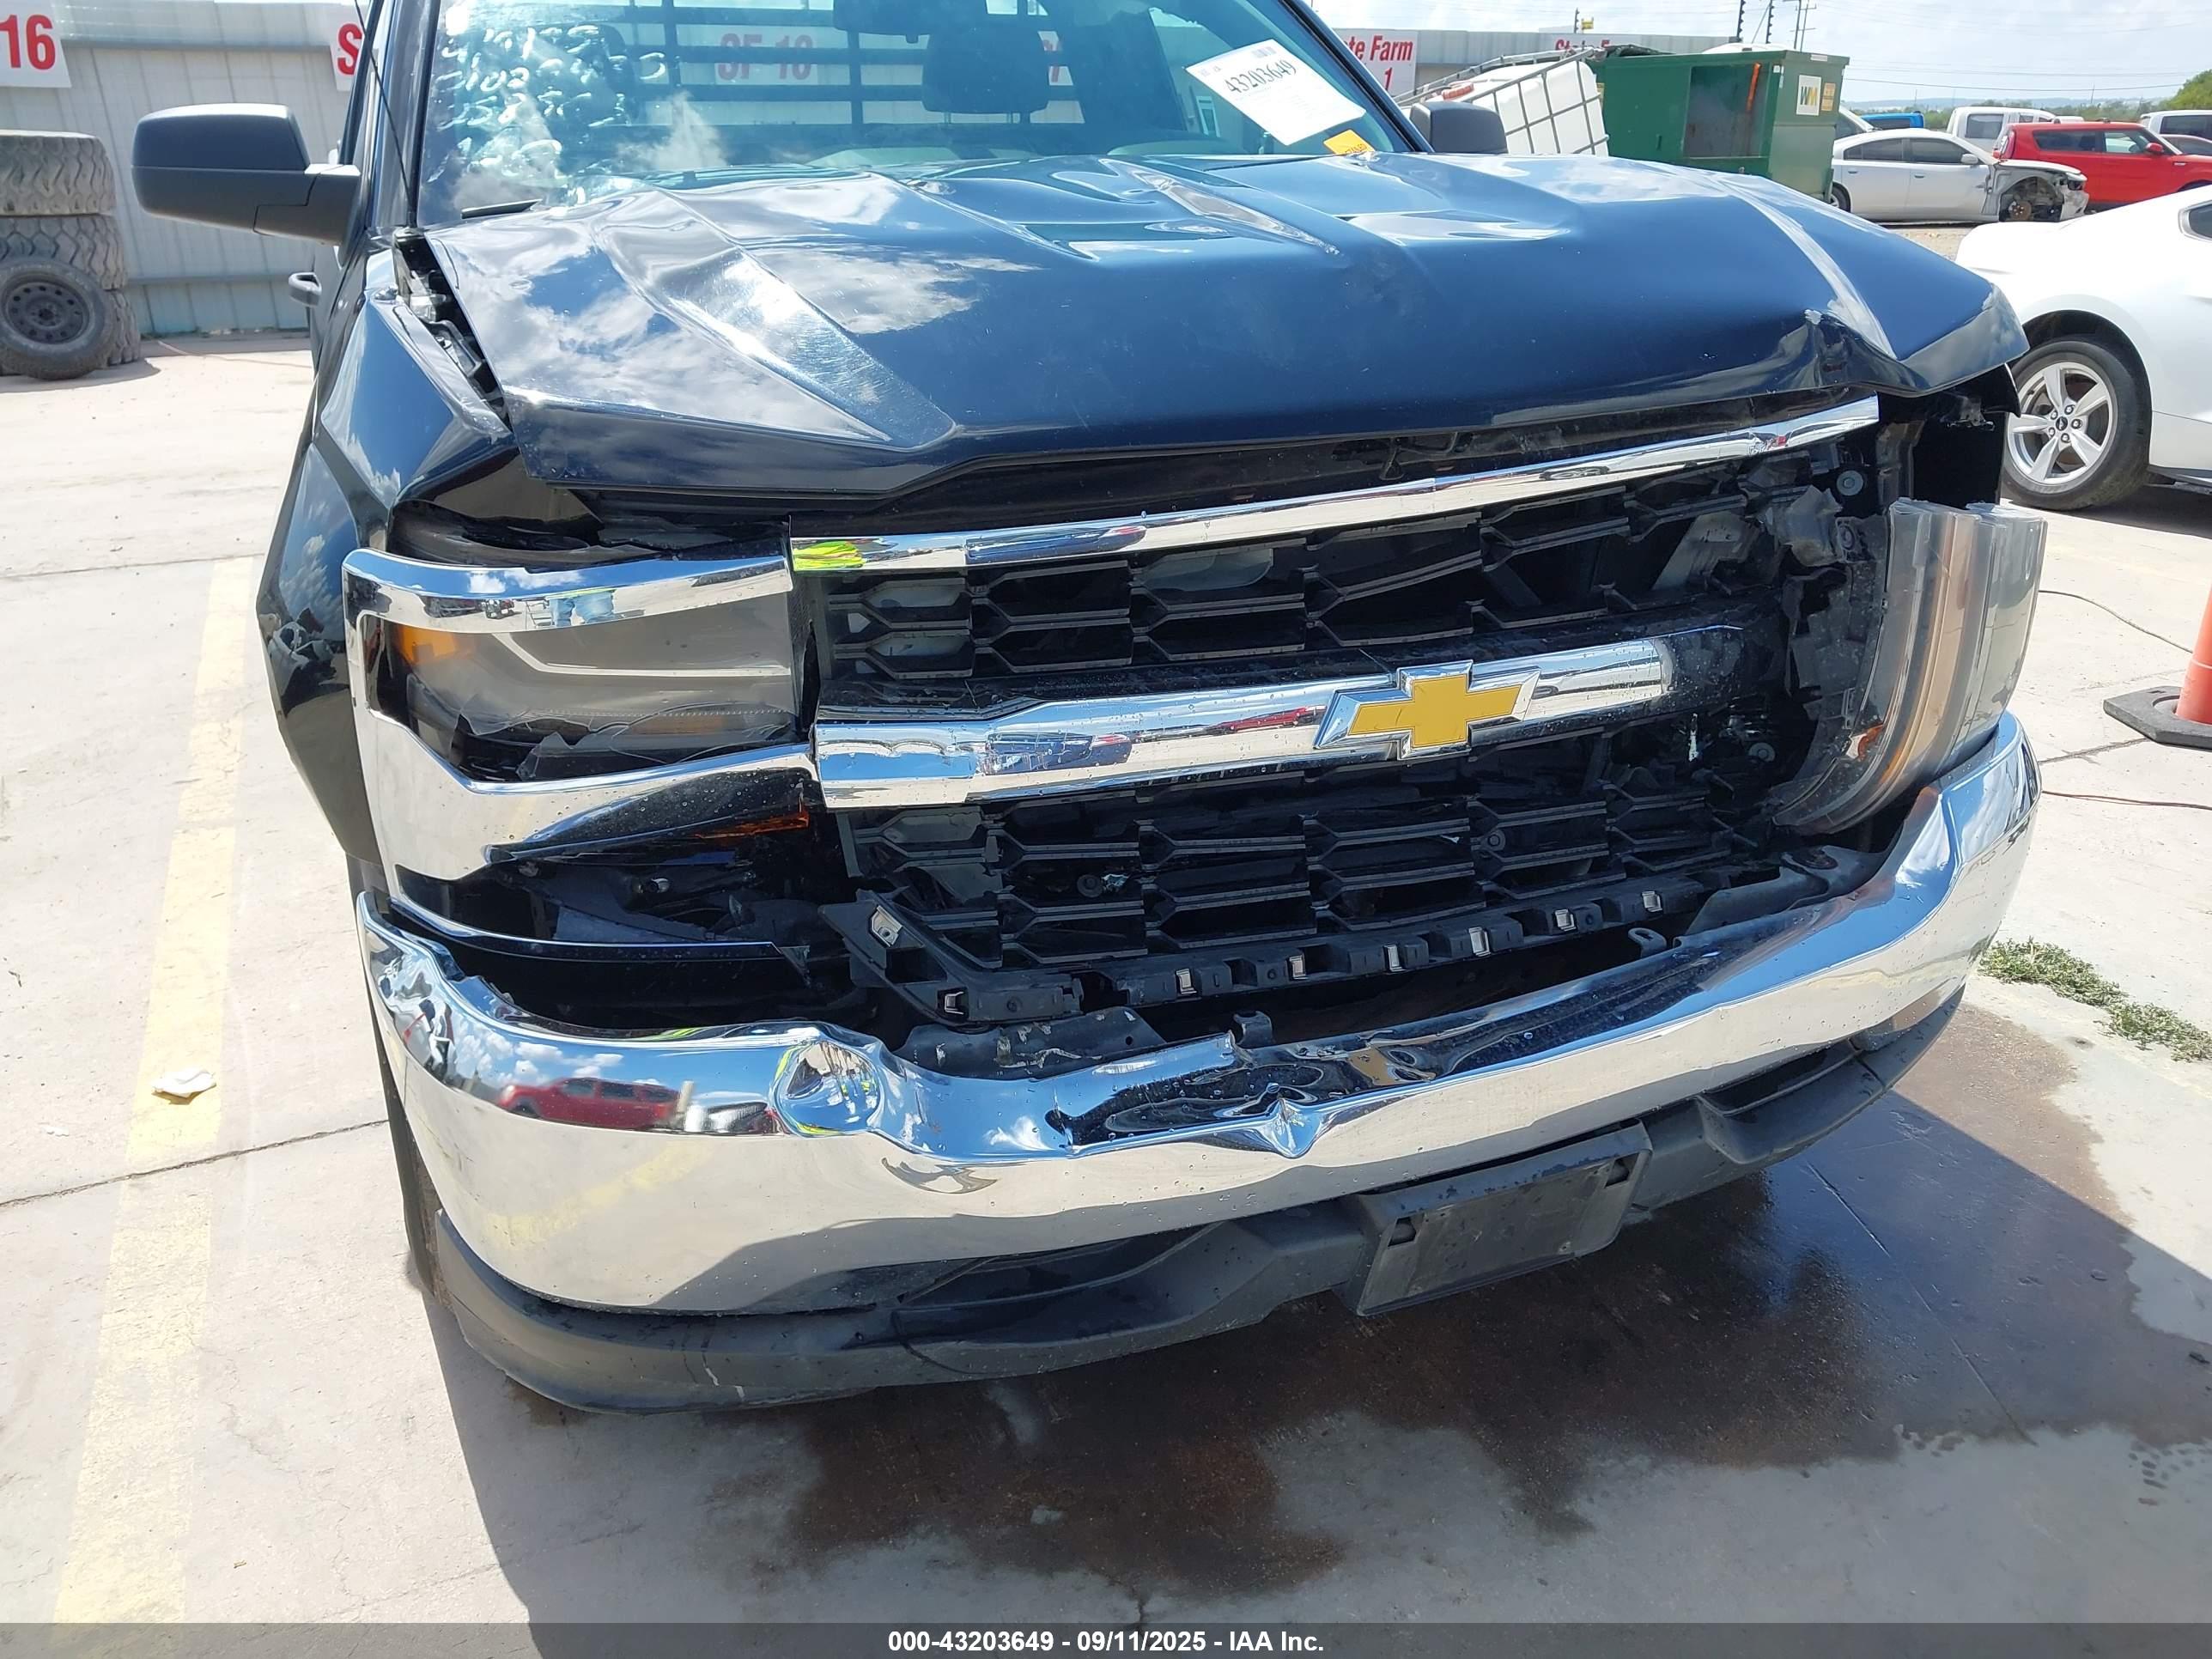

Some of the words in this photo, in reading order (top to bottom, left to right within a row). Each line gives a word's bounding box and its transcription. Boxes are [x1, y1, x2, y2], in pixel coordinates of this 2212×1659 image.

[0, 14, 57, 70] 16
[1370, 35, 1413, 61] Farm
[1224, 58, 1297, 94] 43203649
